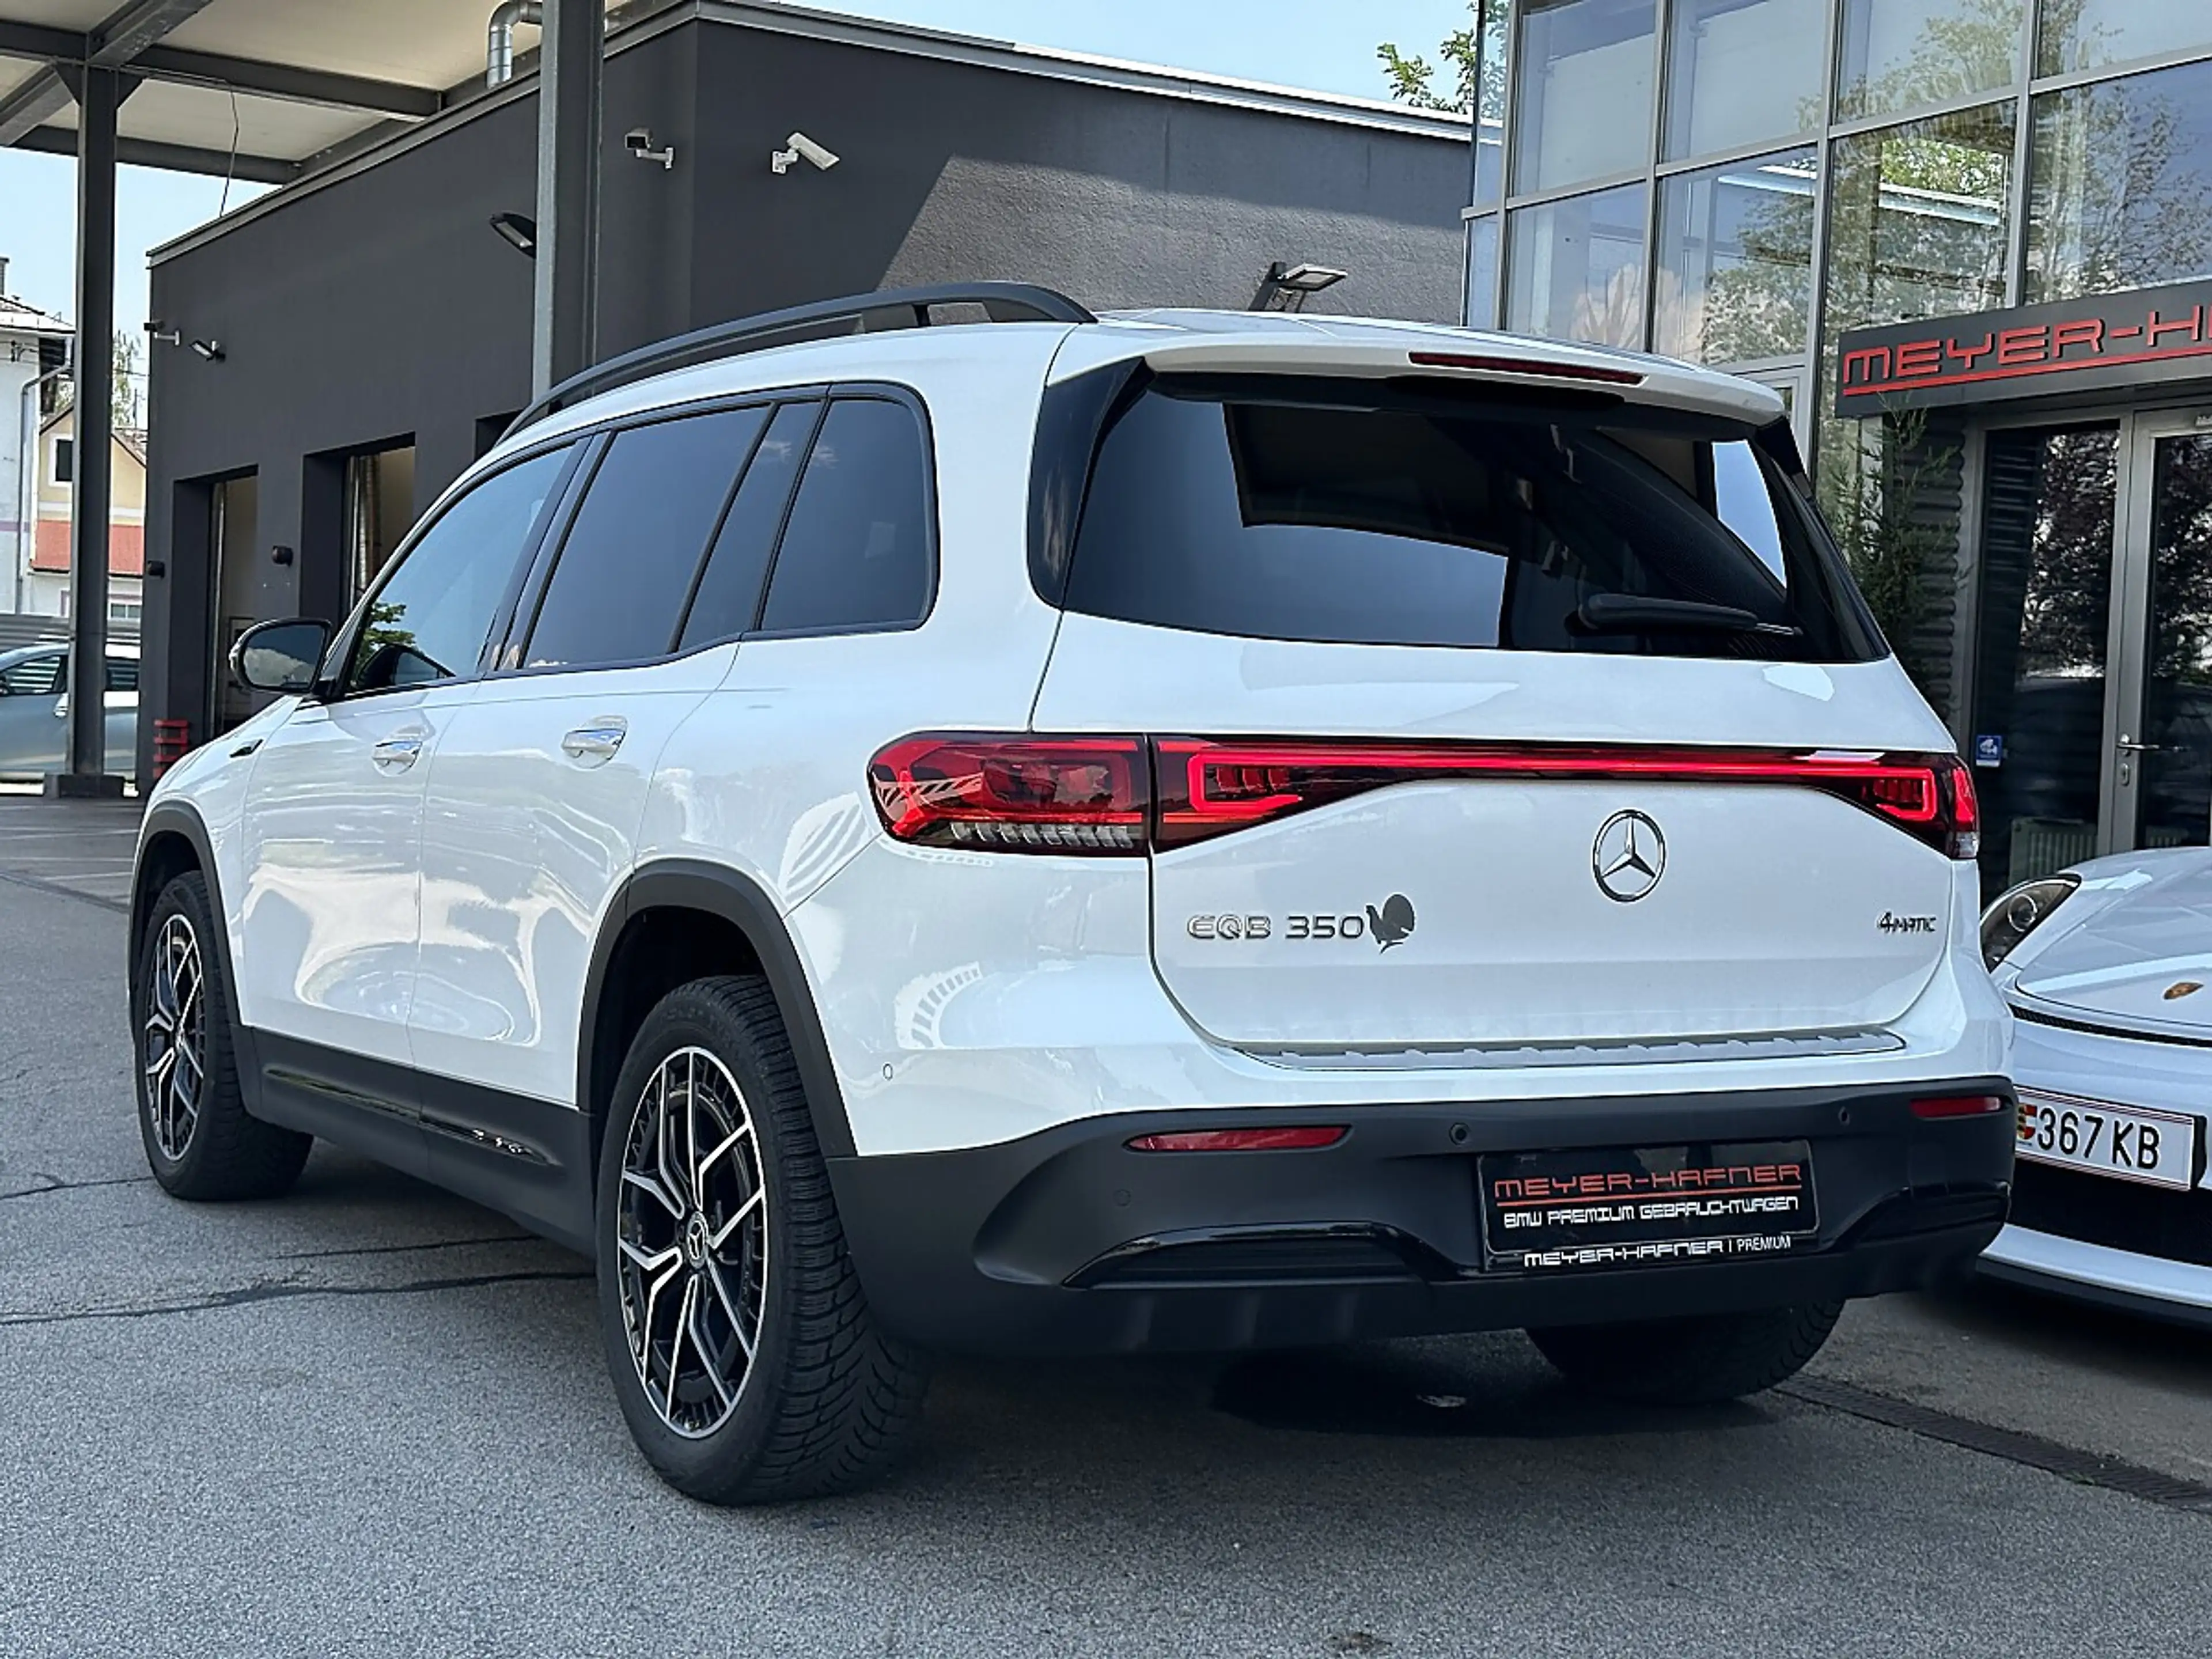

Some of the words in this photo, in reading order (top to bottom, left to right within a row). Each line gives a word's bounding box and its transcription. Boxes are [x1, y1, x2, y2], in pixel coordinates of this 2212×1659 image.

[1843, 303, 2212, 384] MEYER-H
[1187, 915, 1272, 940] EQB
[1285, 915, 1365, 940] 350
[2037, 1107, 2104, 1159] 367
[2112, 1119, 2160, 1169] KB
[1494, 1164, 1802, 1198] MEYER-HAFNER
[1503, 1210, 1542, 1229] BMW
[1547, 1205, 1634, 1225] PREMIUM
[1638, 1196, 1798, 1219] GEBRAUCHTWAGEN
[1524, 1240, 1724, 1267] MEYER-HAFNER
[1736, 1235, 1791, 1252] PREMIUM
